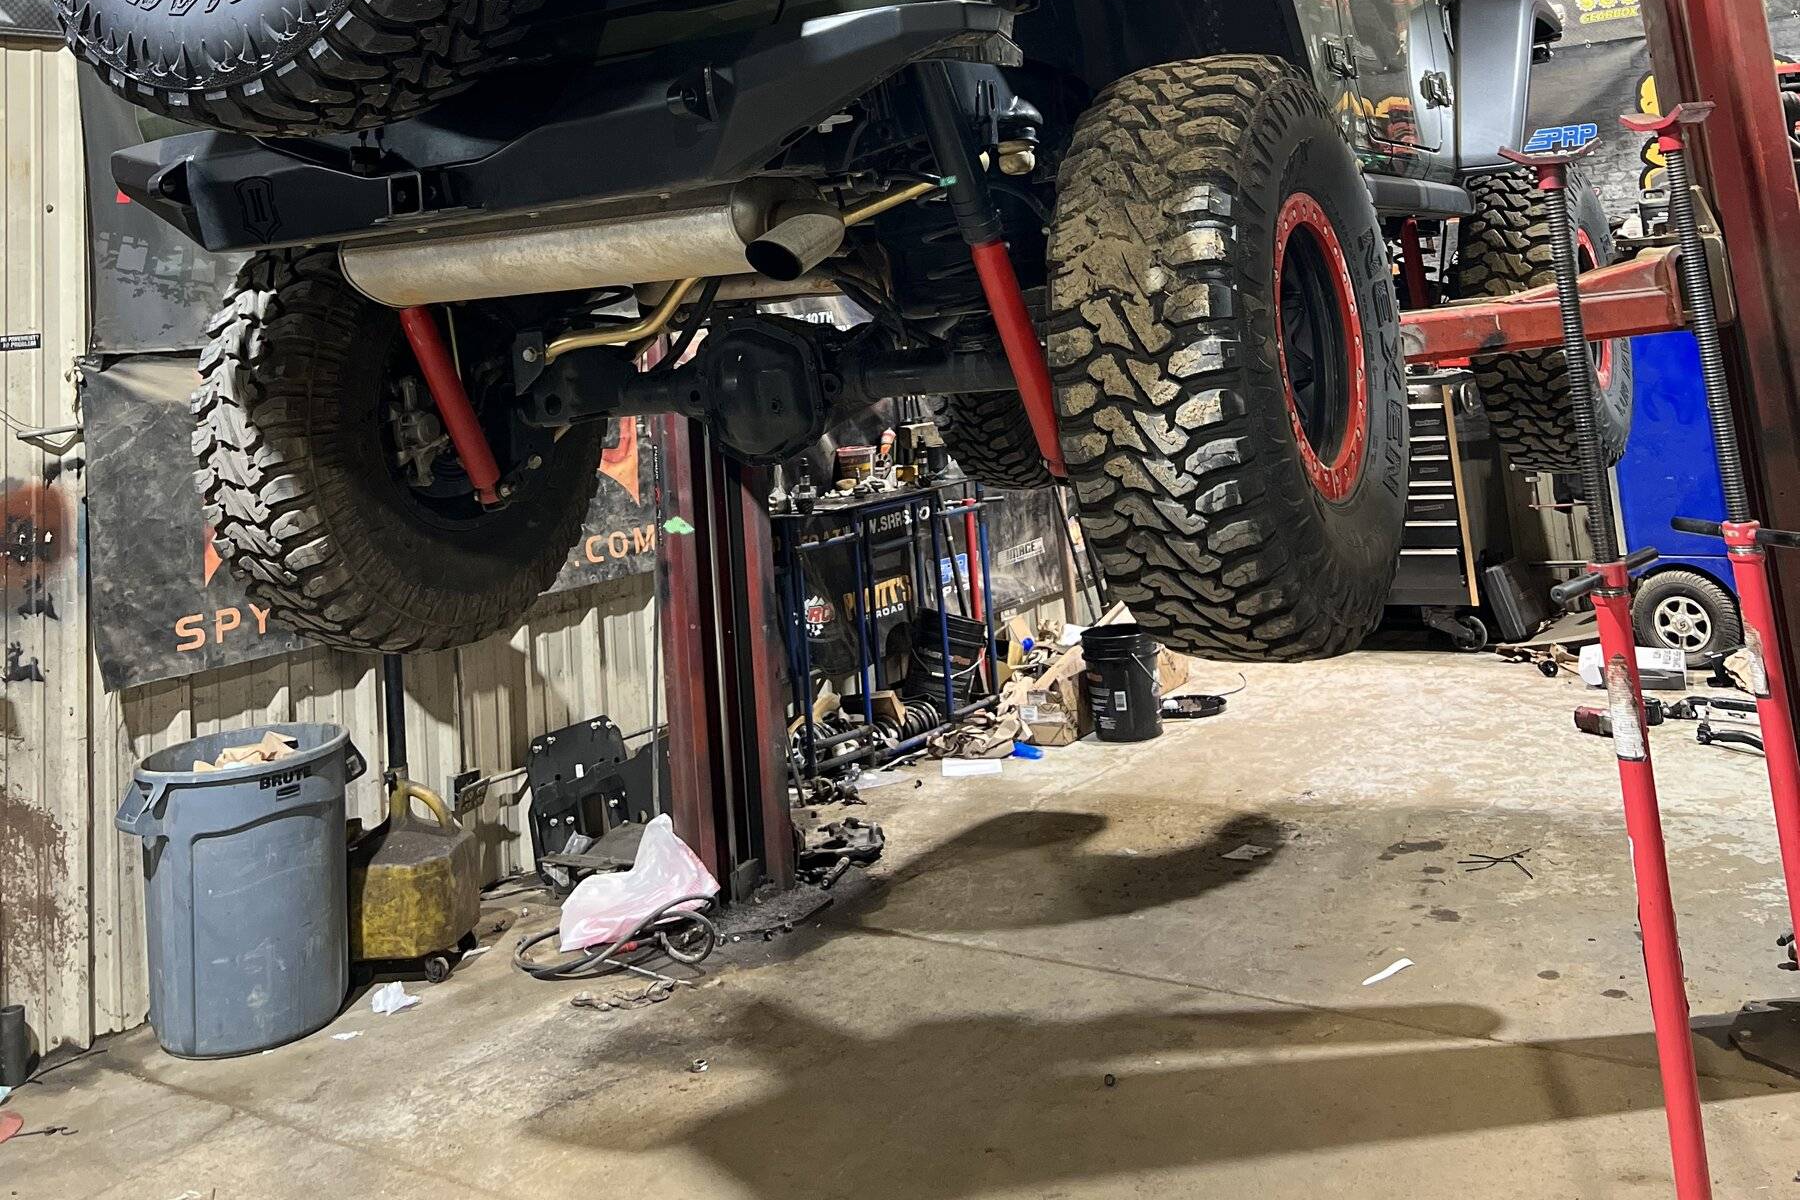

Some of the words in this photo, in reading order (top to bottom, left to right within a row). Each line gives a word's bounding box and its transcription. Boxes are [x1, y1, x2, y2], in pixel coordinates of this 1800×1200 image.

[1357, 225, 1404, 498] NEXEN
[174, 603, 271, 652] SPY
[259, 765, 313, 791] BRUTE
